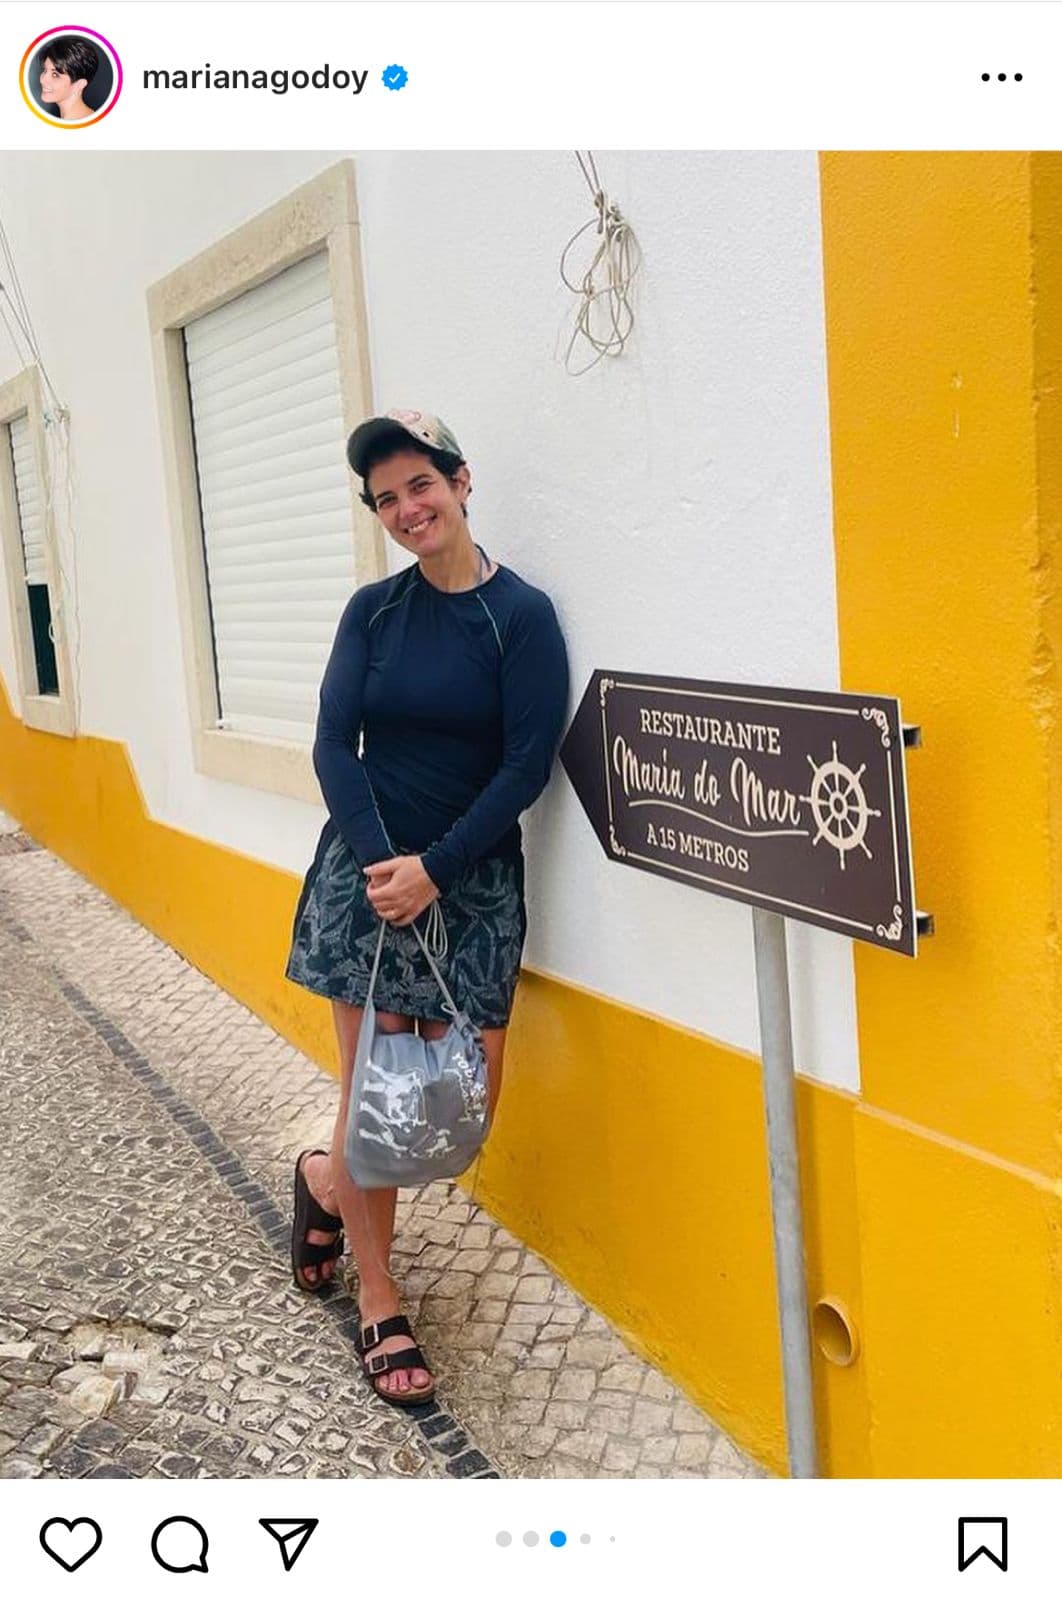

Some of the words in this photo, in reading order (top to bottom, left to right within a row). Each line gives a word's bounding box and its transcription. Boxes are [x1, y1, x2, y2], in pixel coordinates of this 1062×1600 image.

[640, 708, 782, 756] RESTAURANTE
[613, 735, 686, 797] Maria
[693, 759, 721, 806] do
[730, 757, 801, 826] Mar
[646, 823, 658, 846] A
[659, 827, 677, 851] 15
[679, 832, 750, 873] METROS
